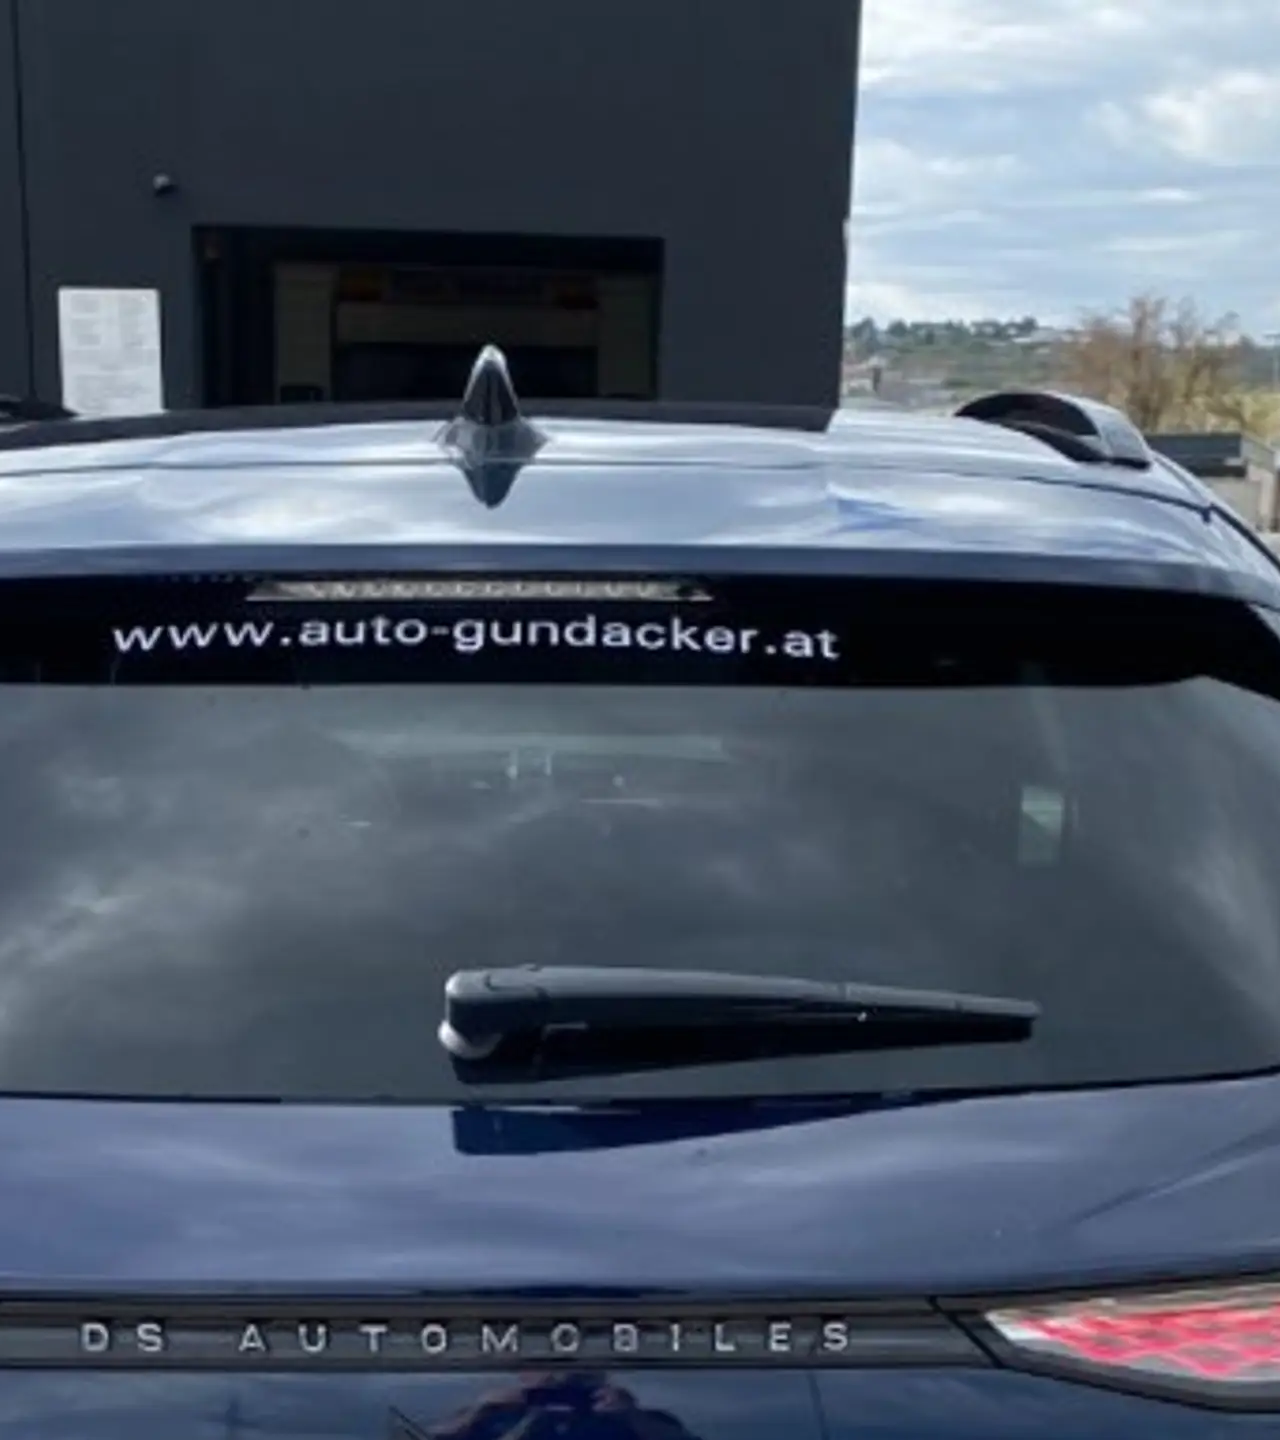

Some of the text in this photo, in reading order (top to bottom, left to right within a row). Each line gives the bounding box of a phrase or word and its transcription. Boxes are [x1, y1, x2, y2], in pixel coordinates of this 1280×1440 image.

[113, 614, 842, 661] www.auto-gundacker.at
[80, 1322, 851, 1352] DS AUTOMOBILES
